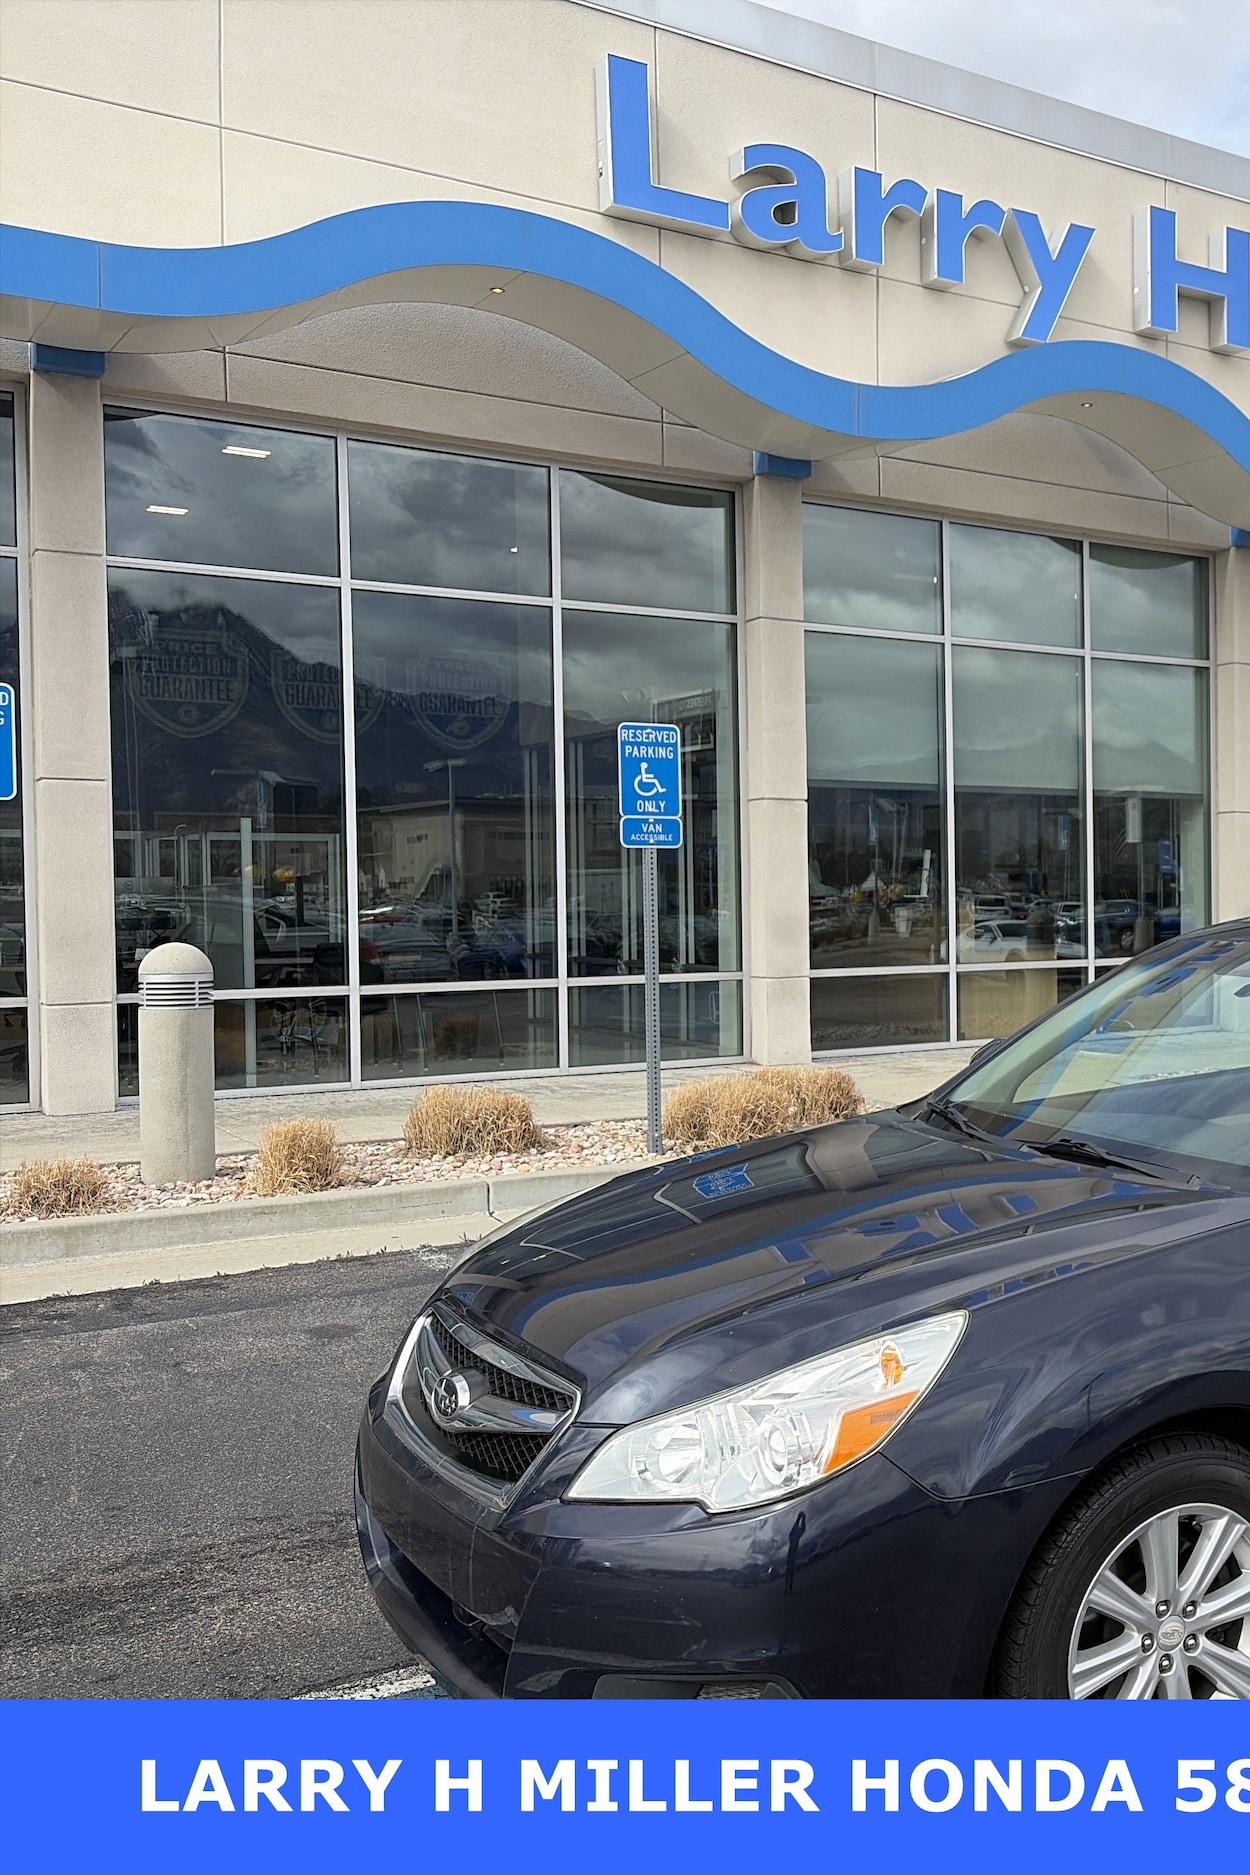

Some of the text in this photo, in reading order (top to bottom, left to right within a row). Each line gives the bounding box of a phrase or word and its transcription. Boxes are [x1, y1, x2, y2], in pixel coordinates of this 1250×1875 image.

[602, 52, 1096, 345] Larry
[621, 728, 677, 743] RESERVED
[625, 745, 674, 759] PARKING
[636, 800, 666, 813] ONLY
[641, 823, 663, 833] VAN
[630, 833, 673, 842] ACCESSIBLE
